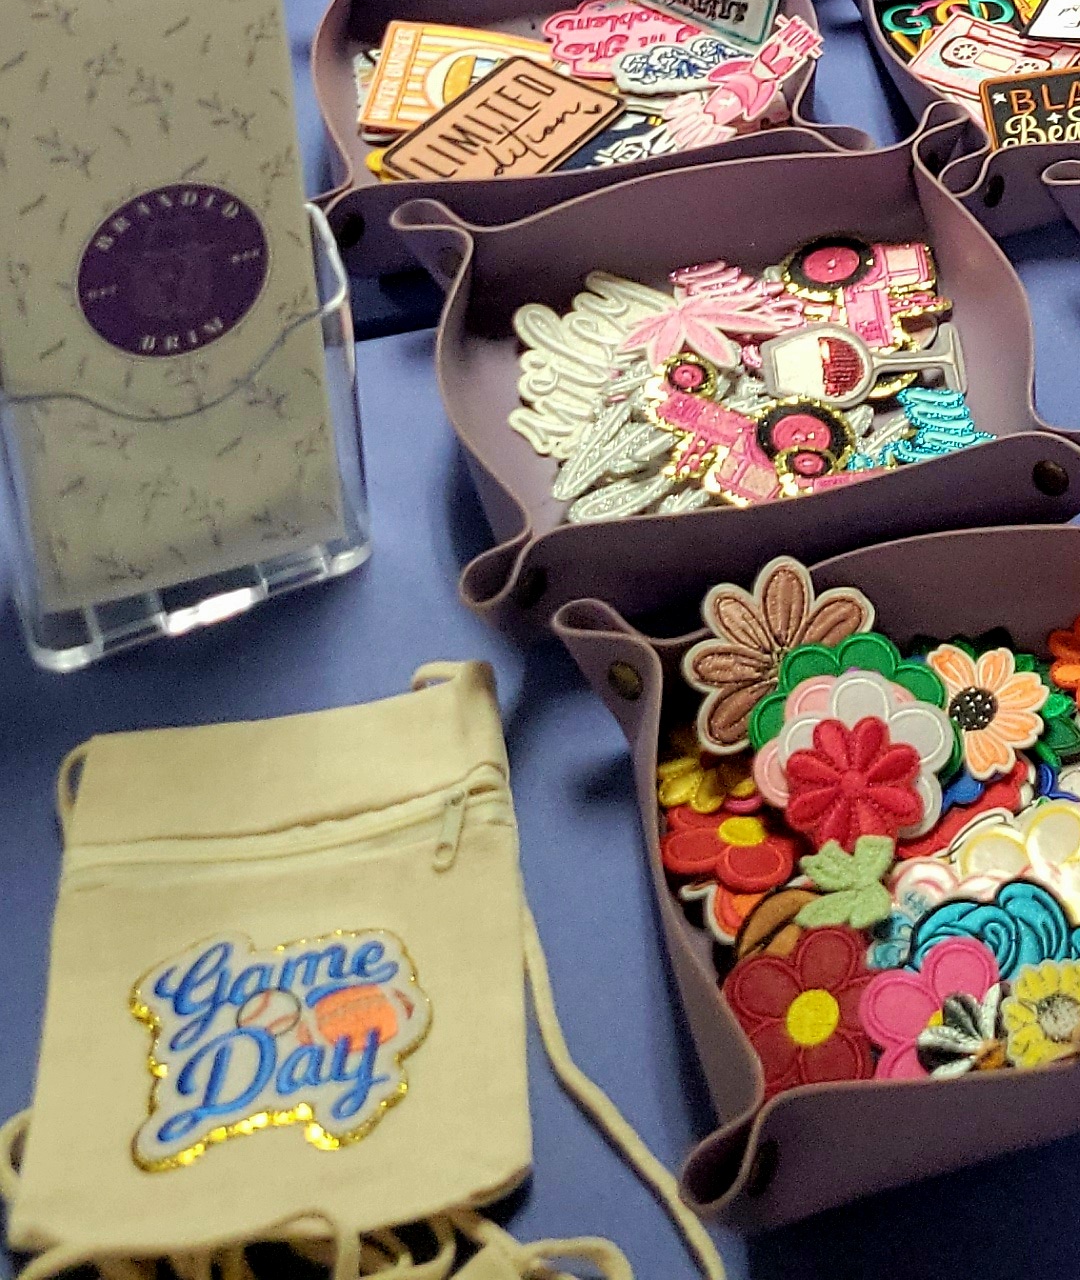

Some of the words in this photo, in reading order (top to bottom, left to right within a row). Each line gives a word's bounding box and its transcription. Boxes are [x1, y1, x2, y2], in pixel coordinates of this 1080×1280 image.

[556, 9, 683, 32] oblem
[408, 73, 555, 179] LIMITED
[153, 941, 400, 1051] Game
[156, 1027, 391, 1143] Day
